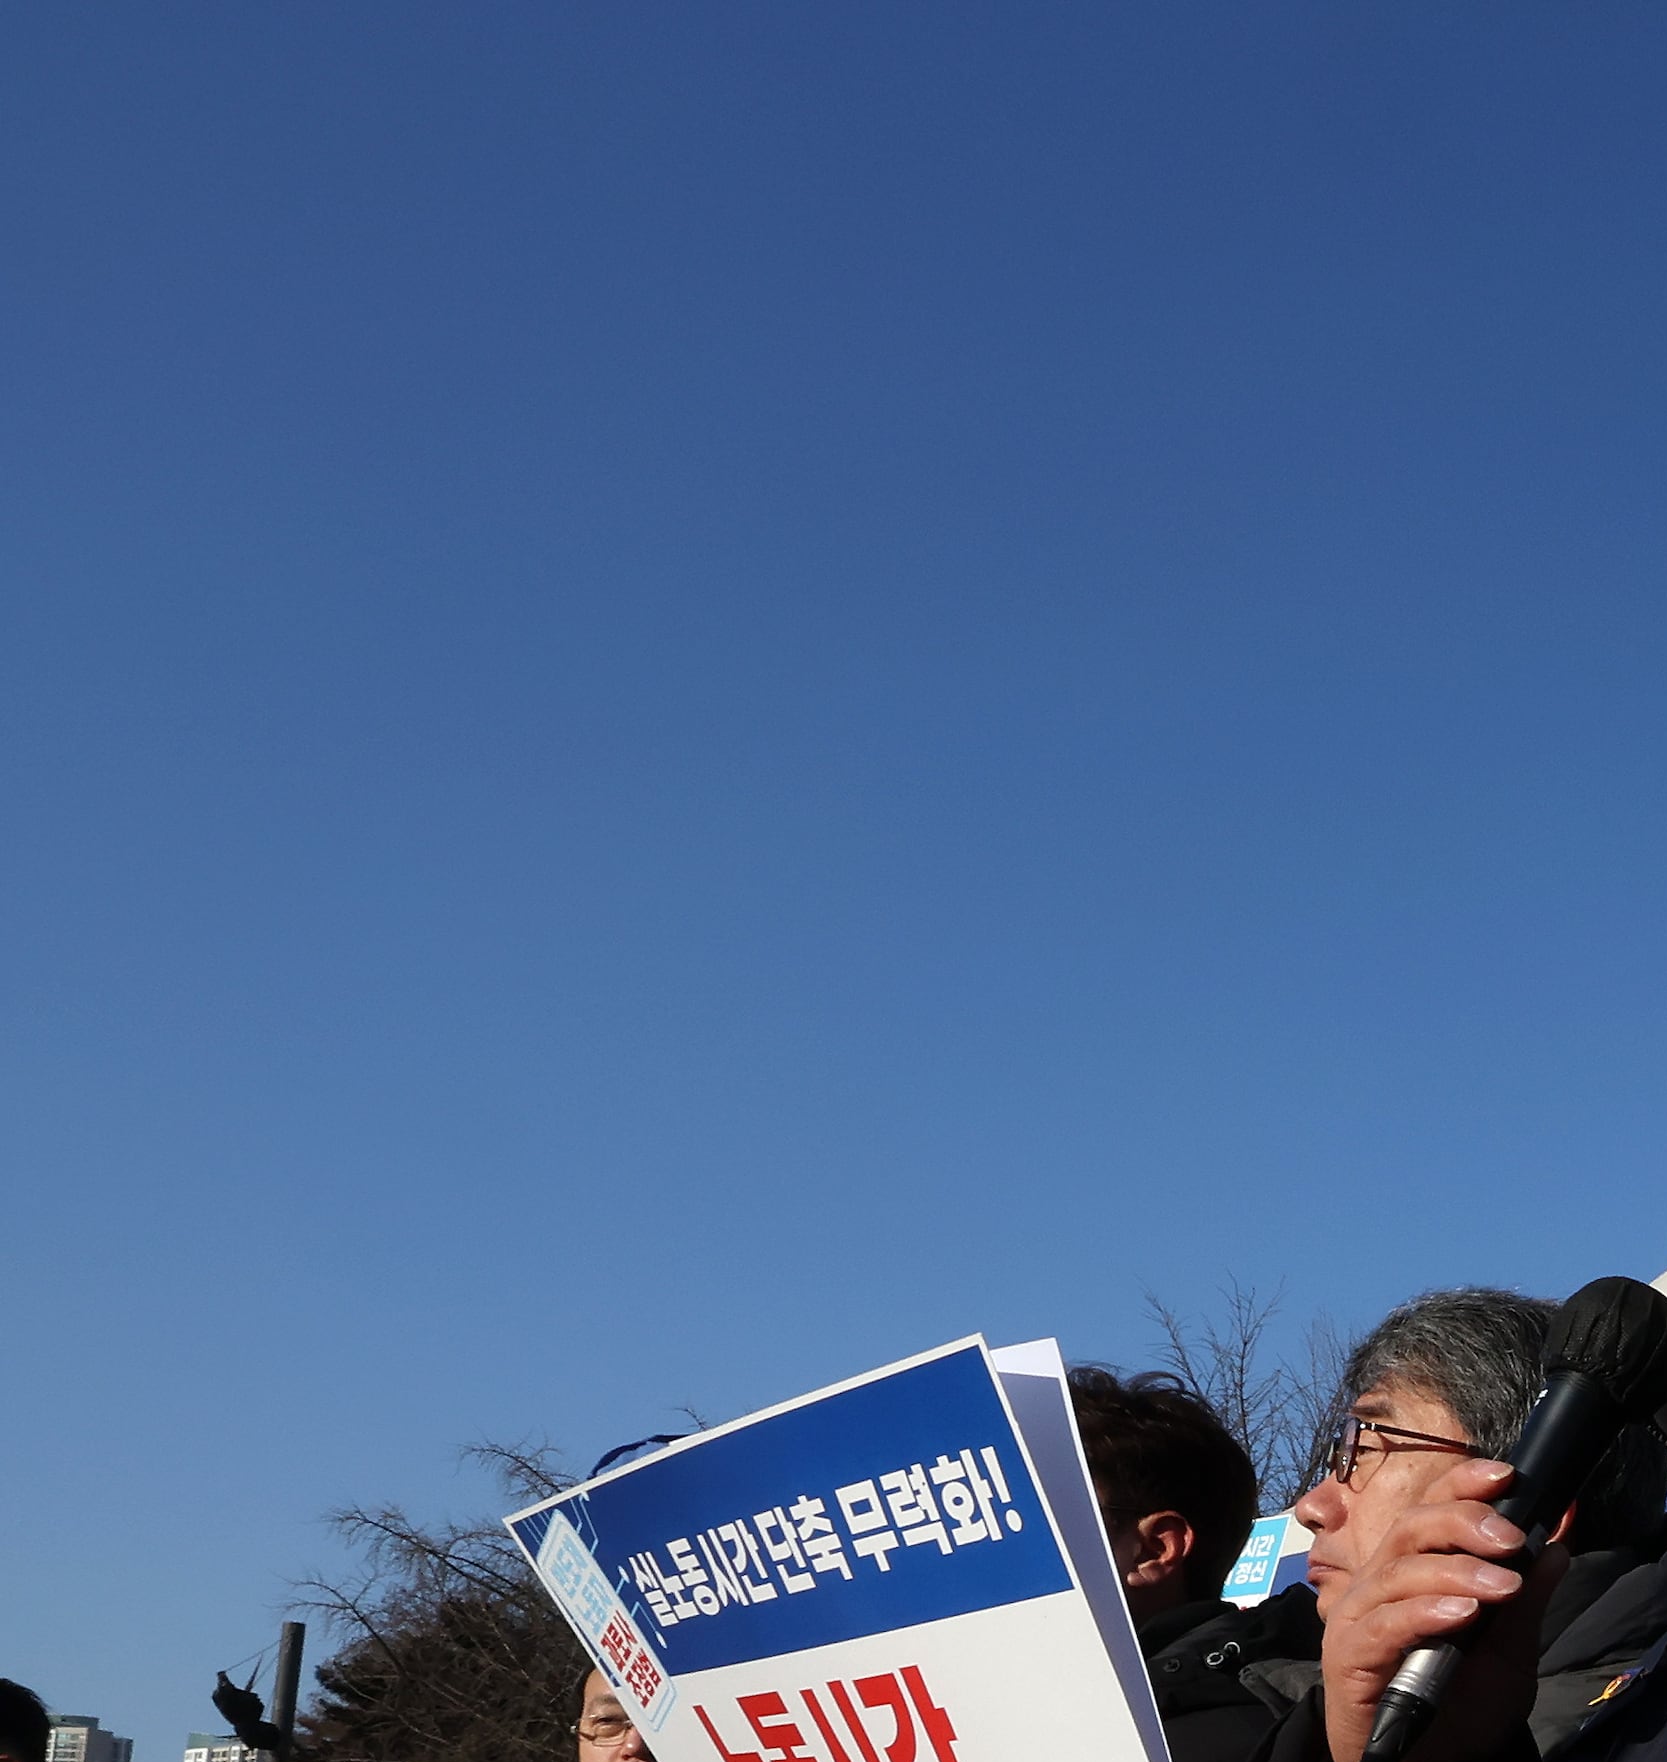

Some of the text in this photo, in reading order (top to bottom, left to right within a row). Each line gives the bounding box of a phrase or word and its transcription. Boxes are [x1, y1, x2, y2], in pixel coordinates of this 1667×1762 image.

[629, 1446, 1023, 1627] 실노동시간 단축 무력화!
